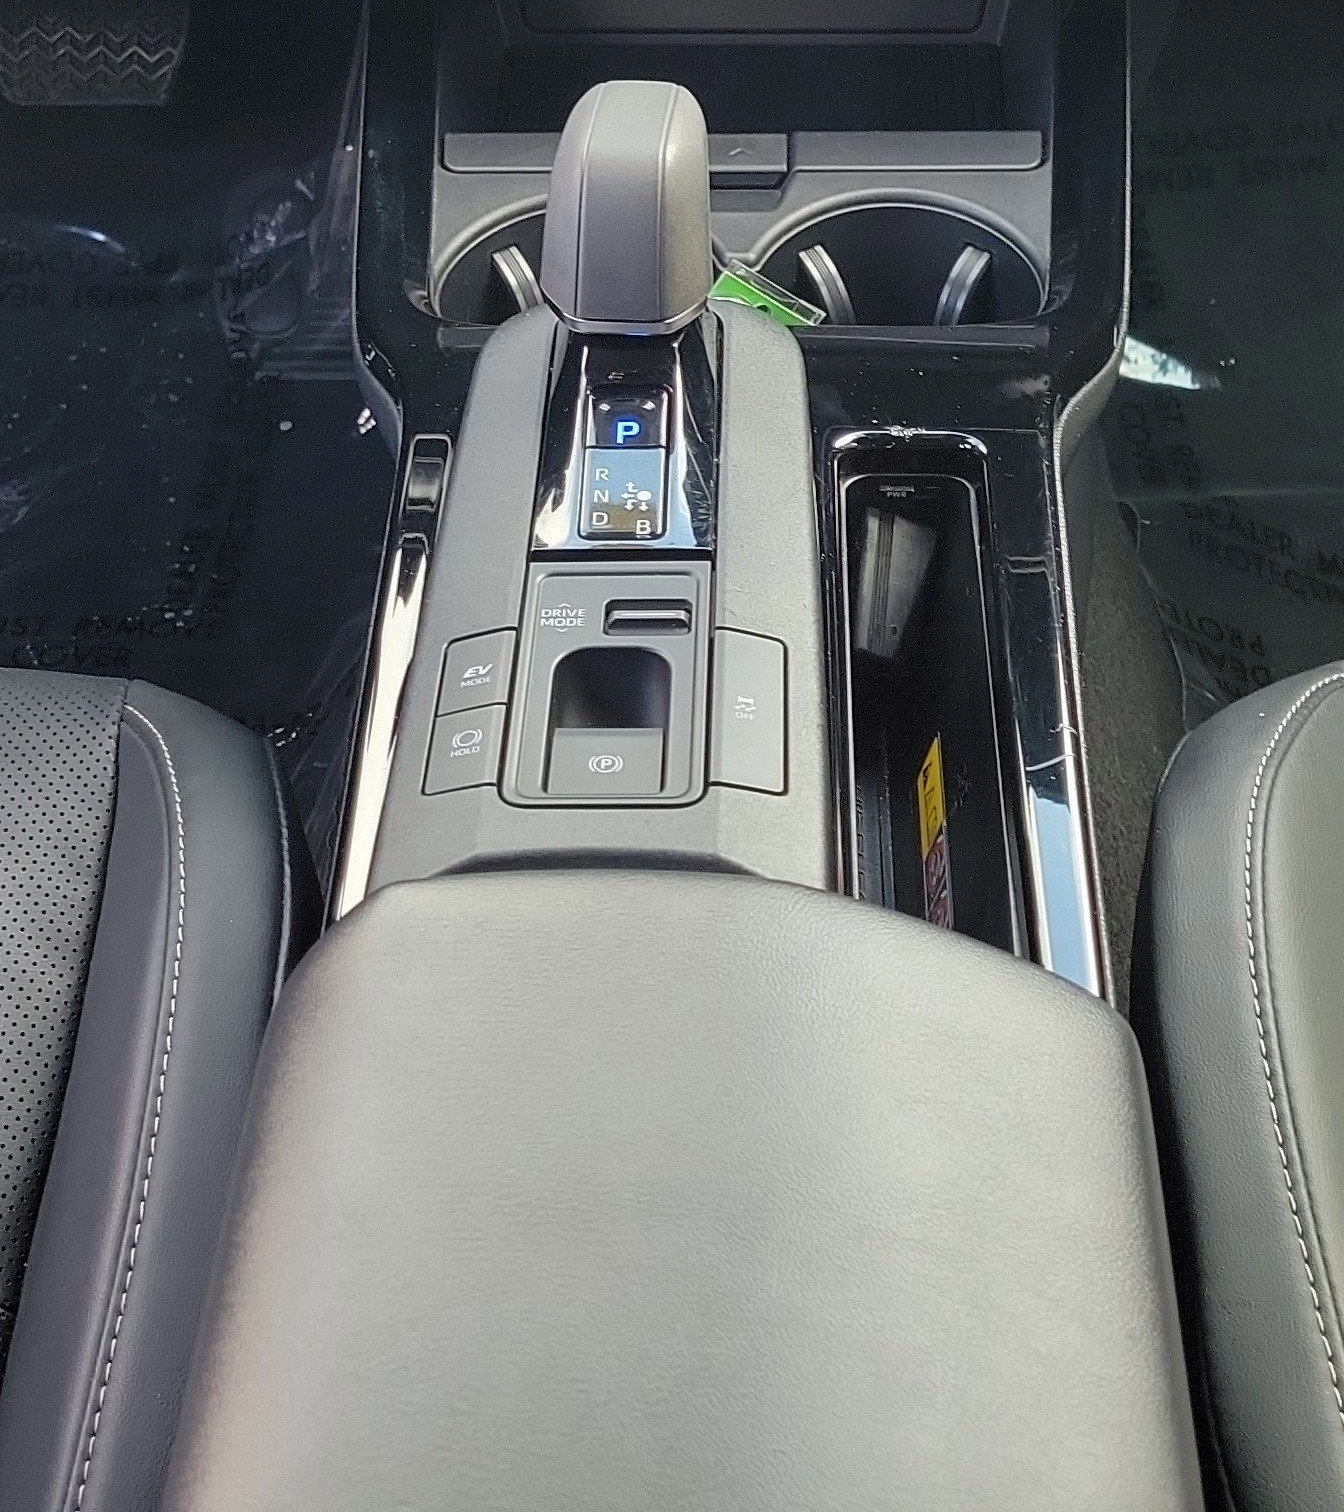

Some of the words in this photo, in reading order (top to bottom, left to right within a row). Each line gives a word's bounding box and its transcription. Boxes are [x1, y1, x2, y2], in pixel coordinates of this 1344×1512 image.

[615, 421, 641, 445] P
[594, 468, 611, 482] R
[593, 489, 610, 503] N
[592, 511, 610, 526] D
[634, 519, 653, 536] B
[540, 607, 587, 618] DRIVE
[540, 617, 586, 628] MODE
[462, 662, 493, 679] EV
[450, 743, 481, 759] HOLD
